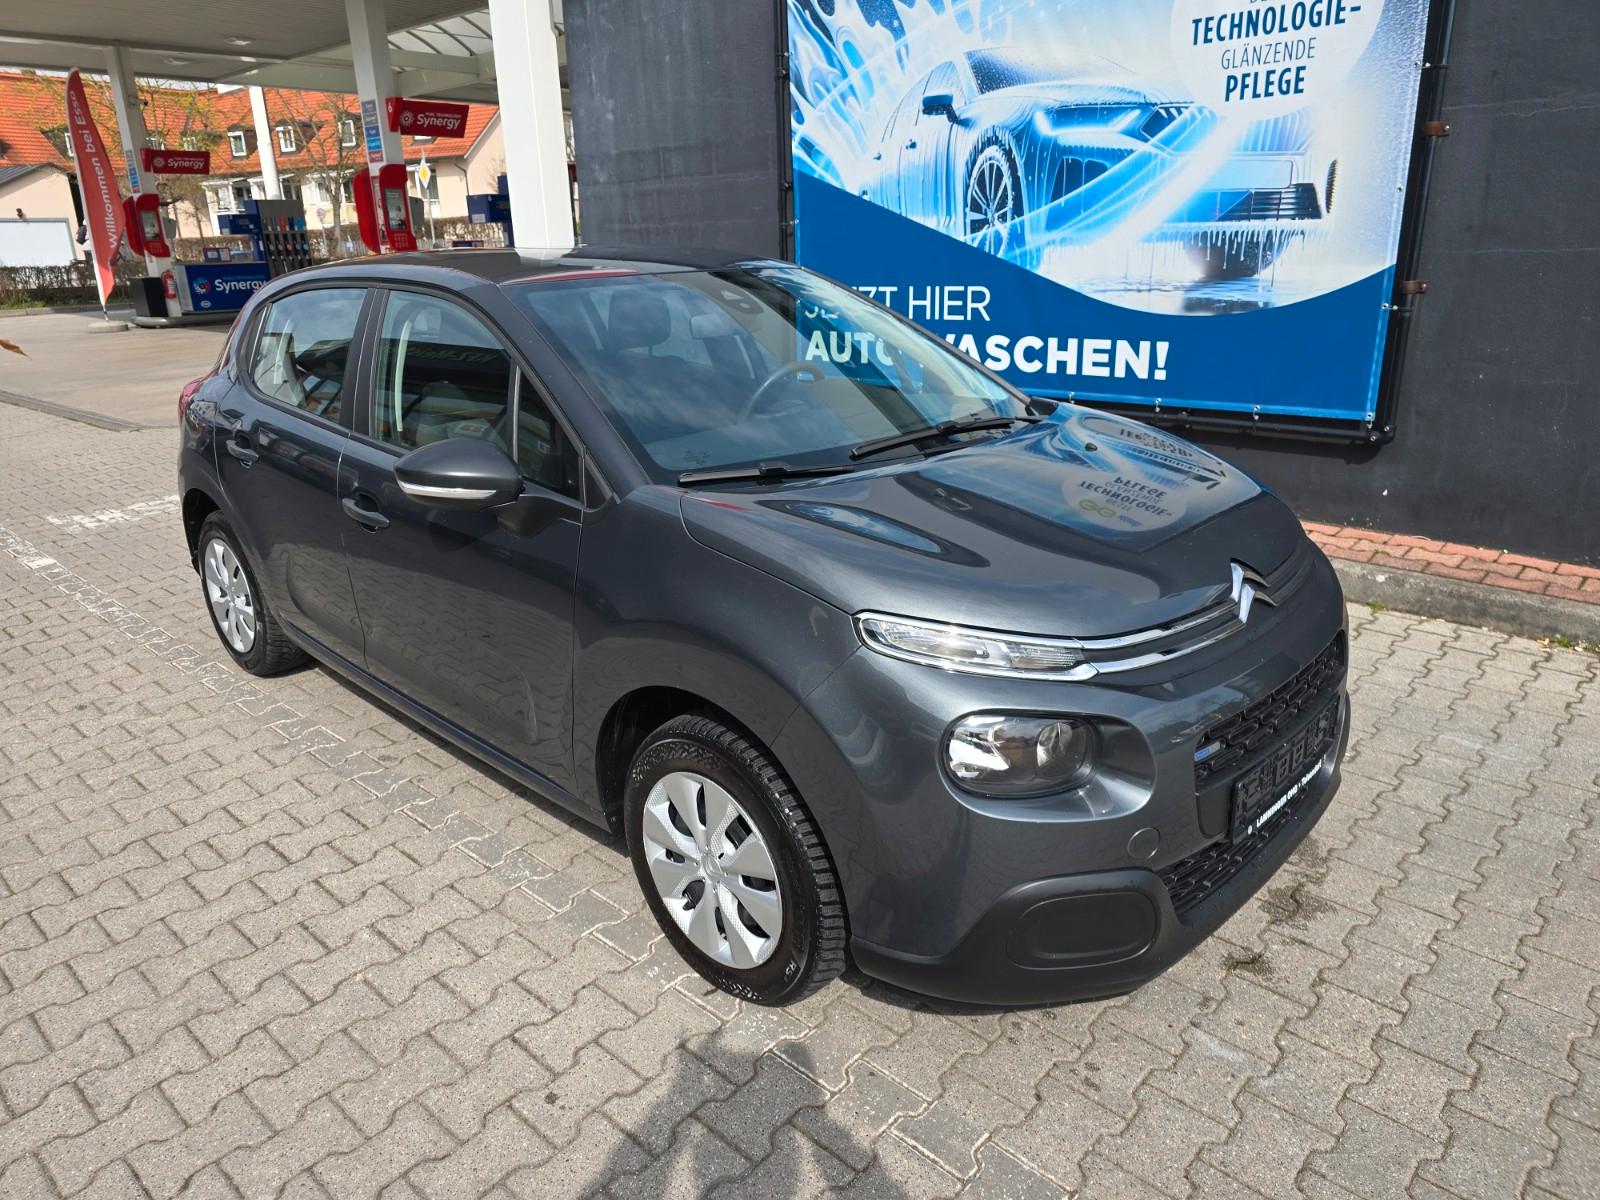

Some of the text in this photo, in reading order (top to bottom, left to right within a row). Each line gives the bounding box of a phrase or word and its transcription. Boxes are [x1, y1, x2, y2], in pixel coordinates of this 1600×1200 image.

[1192, 0, 1361, 45] TECHNOLOGIE-
[1221, 37, 1317, 70] GLÄNZENDE
[1225, 66, 1307, 102] PFLEGE
[416, 114, 461, 130] Synergy
[71, 90, 118, 249] Willkommen bei Esso
[167, 158, 205, 170] Synergy
[214, 278, 266, 294] Synergy
[908, 285, 991, 322] HIER
[945, 333, 1170, 381] ASCHEN!
